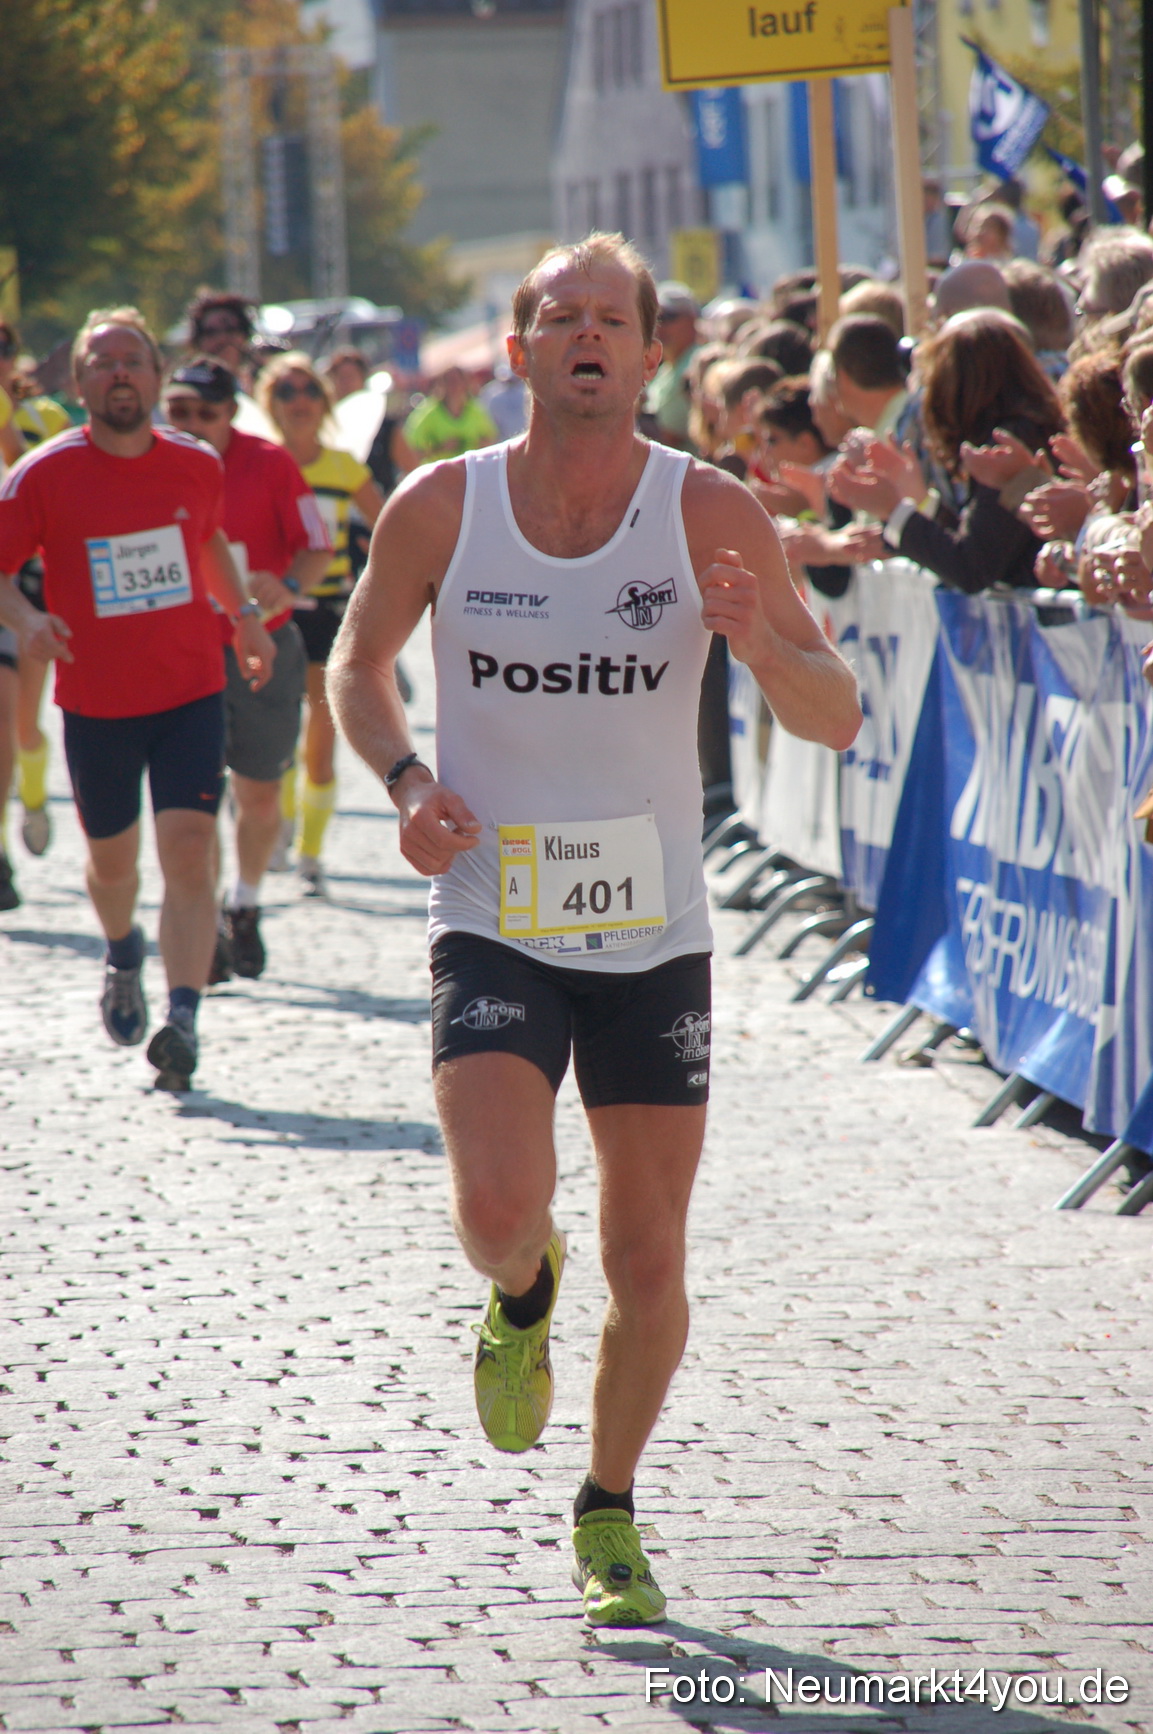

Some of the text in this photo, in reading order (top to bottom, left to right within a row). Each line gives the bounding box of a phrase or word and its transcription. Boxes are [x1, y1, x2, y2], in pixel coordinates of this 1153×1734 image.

[749, 1, 817, 37] lauf
[122, 562, 182, 592] 3346
[466, 590, 550, 607] POSITIV
[463, 606, 550, 619] FITNESS & WELLNESS
[630, 603, 653, 627] IN
[468, 650, 669, 695] Positiv
[544, 835, 600, 860] Klaus
[509, 876, 518, 895] A
[562, 876, 633, 915] 401
